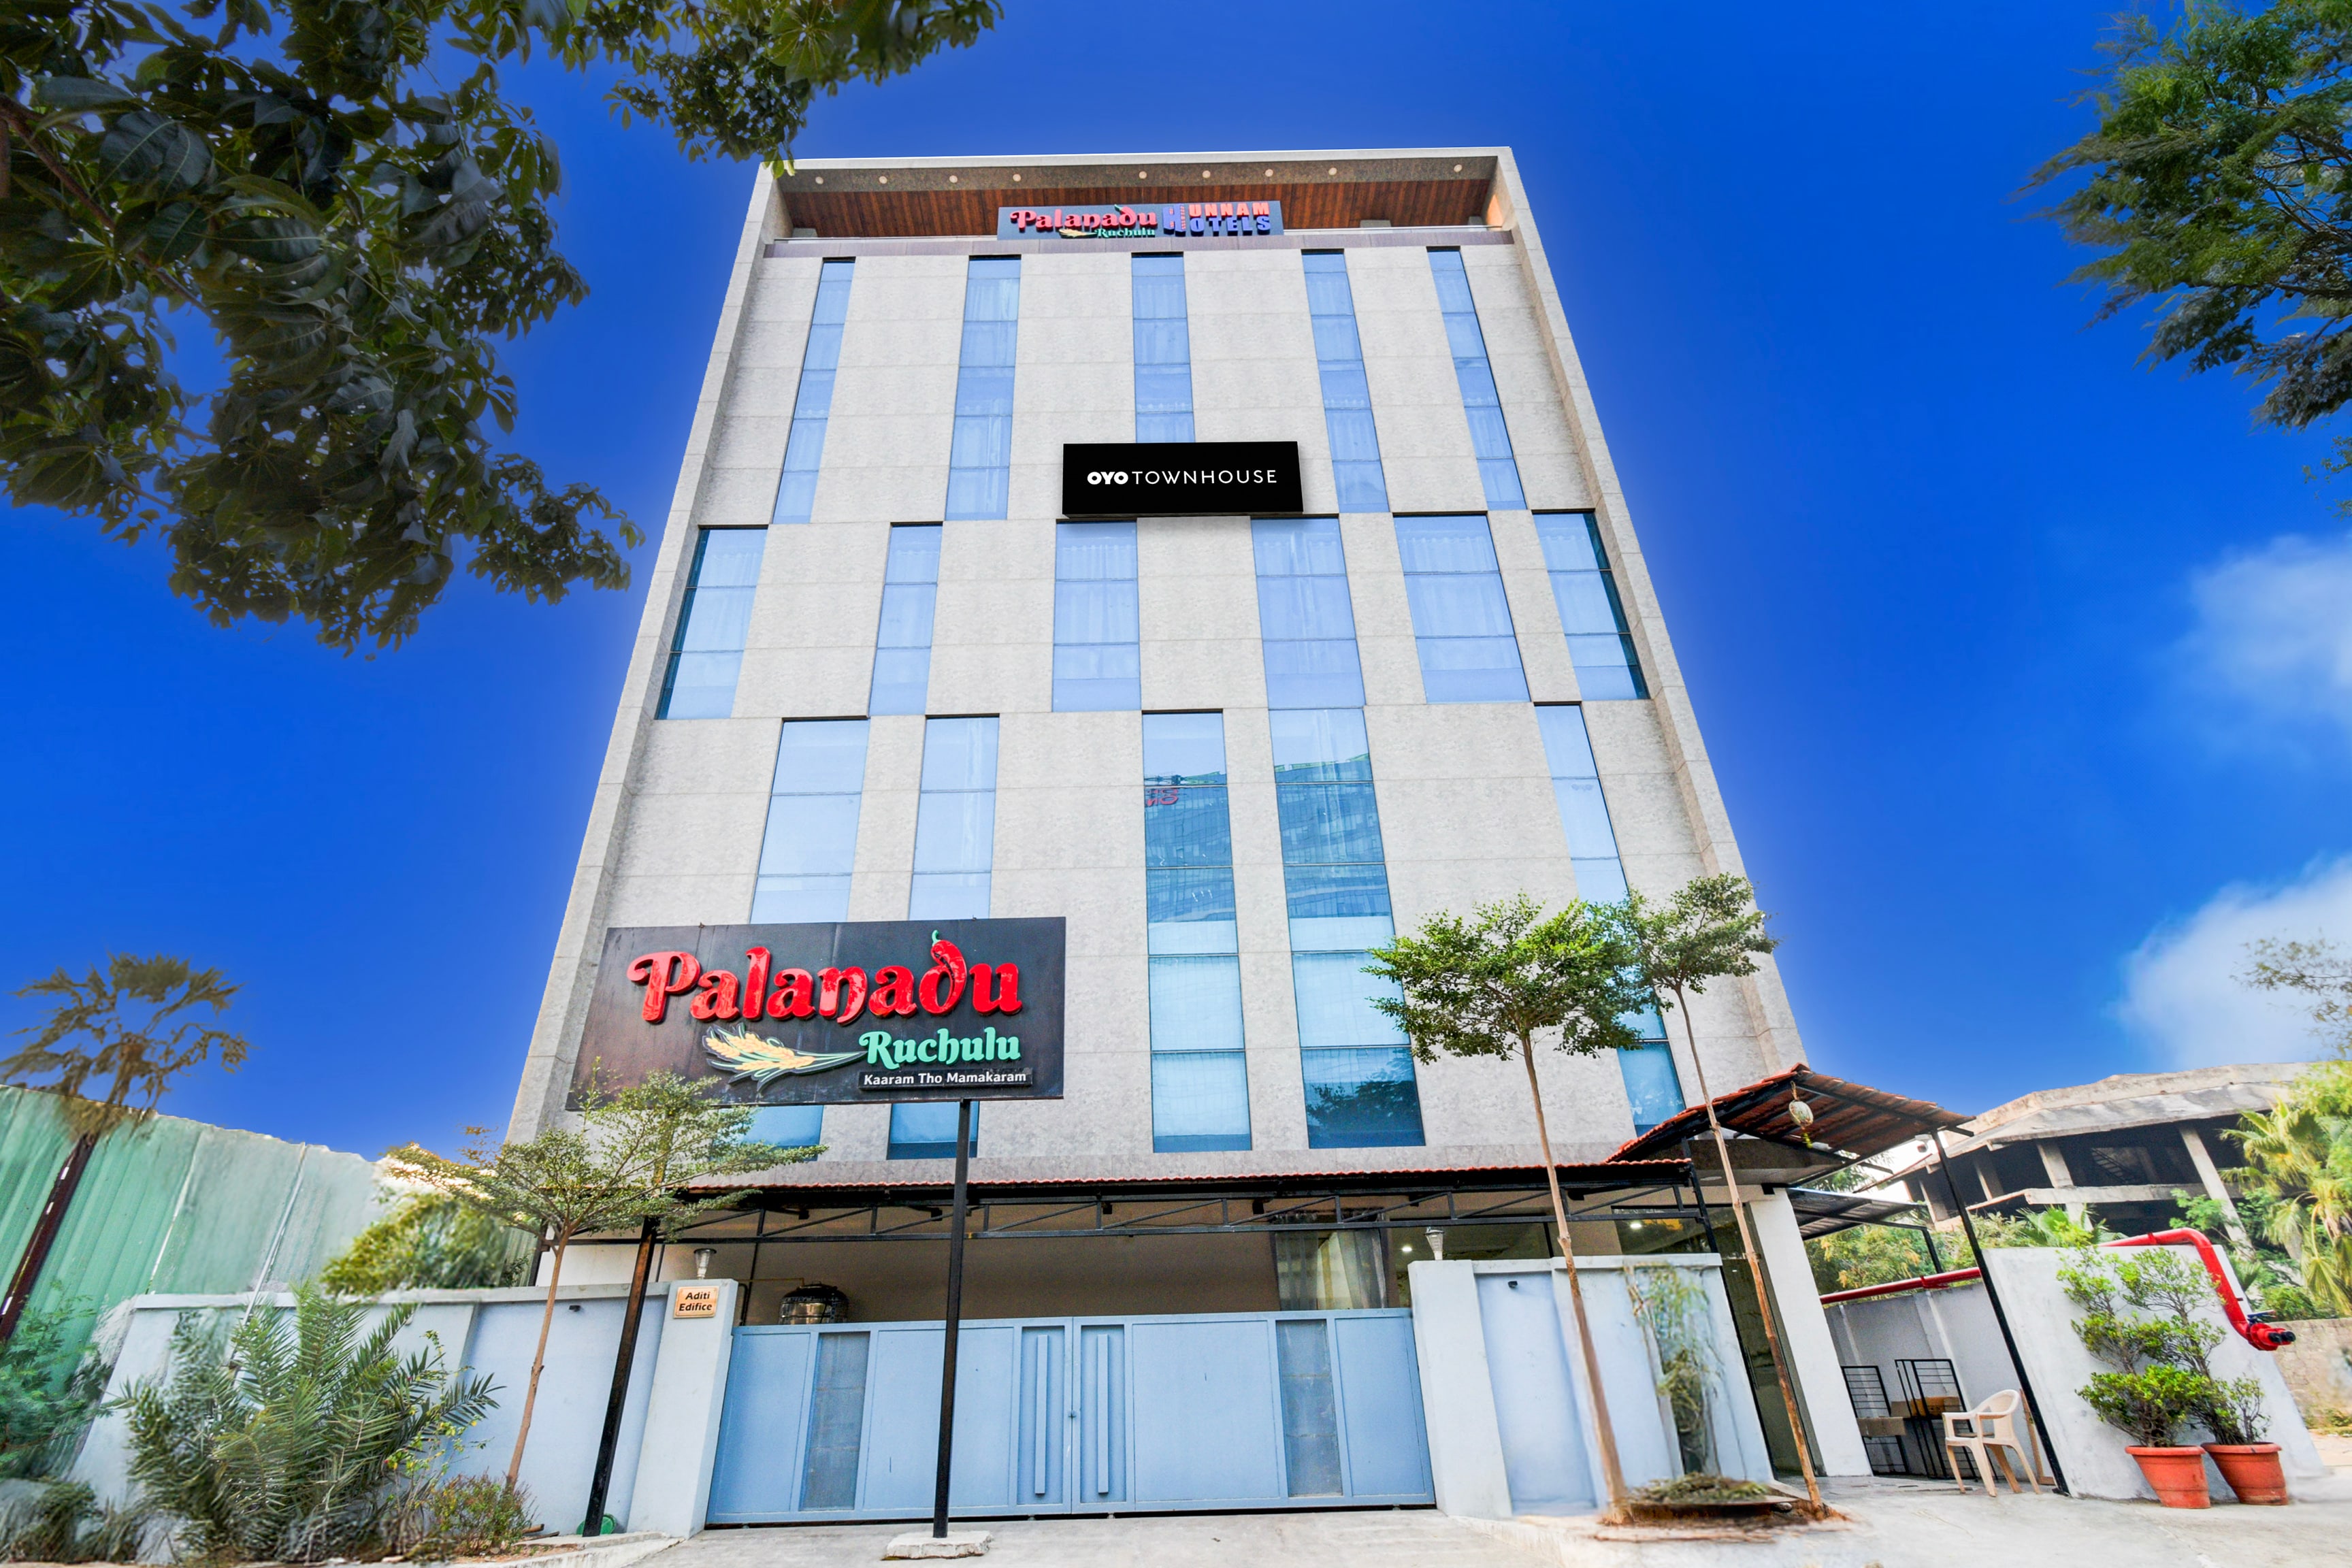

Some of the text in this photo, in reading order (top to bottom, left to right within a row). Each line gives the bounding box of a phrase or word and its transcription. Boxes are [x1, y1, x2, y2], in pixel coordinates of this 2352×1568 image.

[1010, 204, 1158, 232] Palanadu
[1094, 227, 1156, 238] Ruchulu
[1087, 470, 1277, 485] OYO TOWNHOUSE
[626, 930, 1023, 1025] Palanadu
[858, 1026, 1021, 1070] Ruchulu
[864, 1071, 1026, 1085] Kaaram Tho Mamakaram
[685, 1292, 710, 1300] Aditi
[679, 1303, 713, 1311] Edifice
